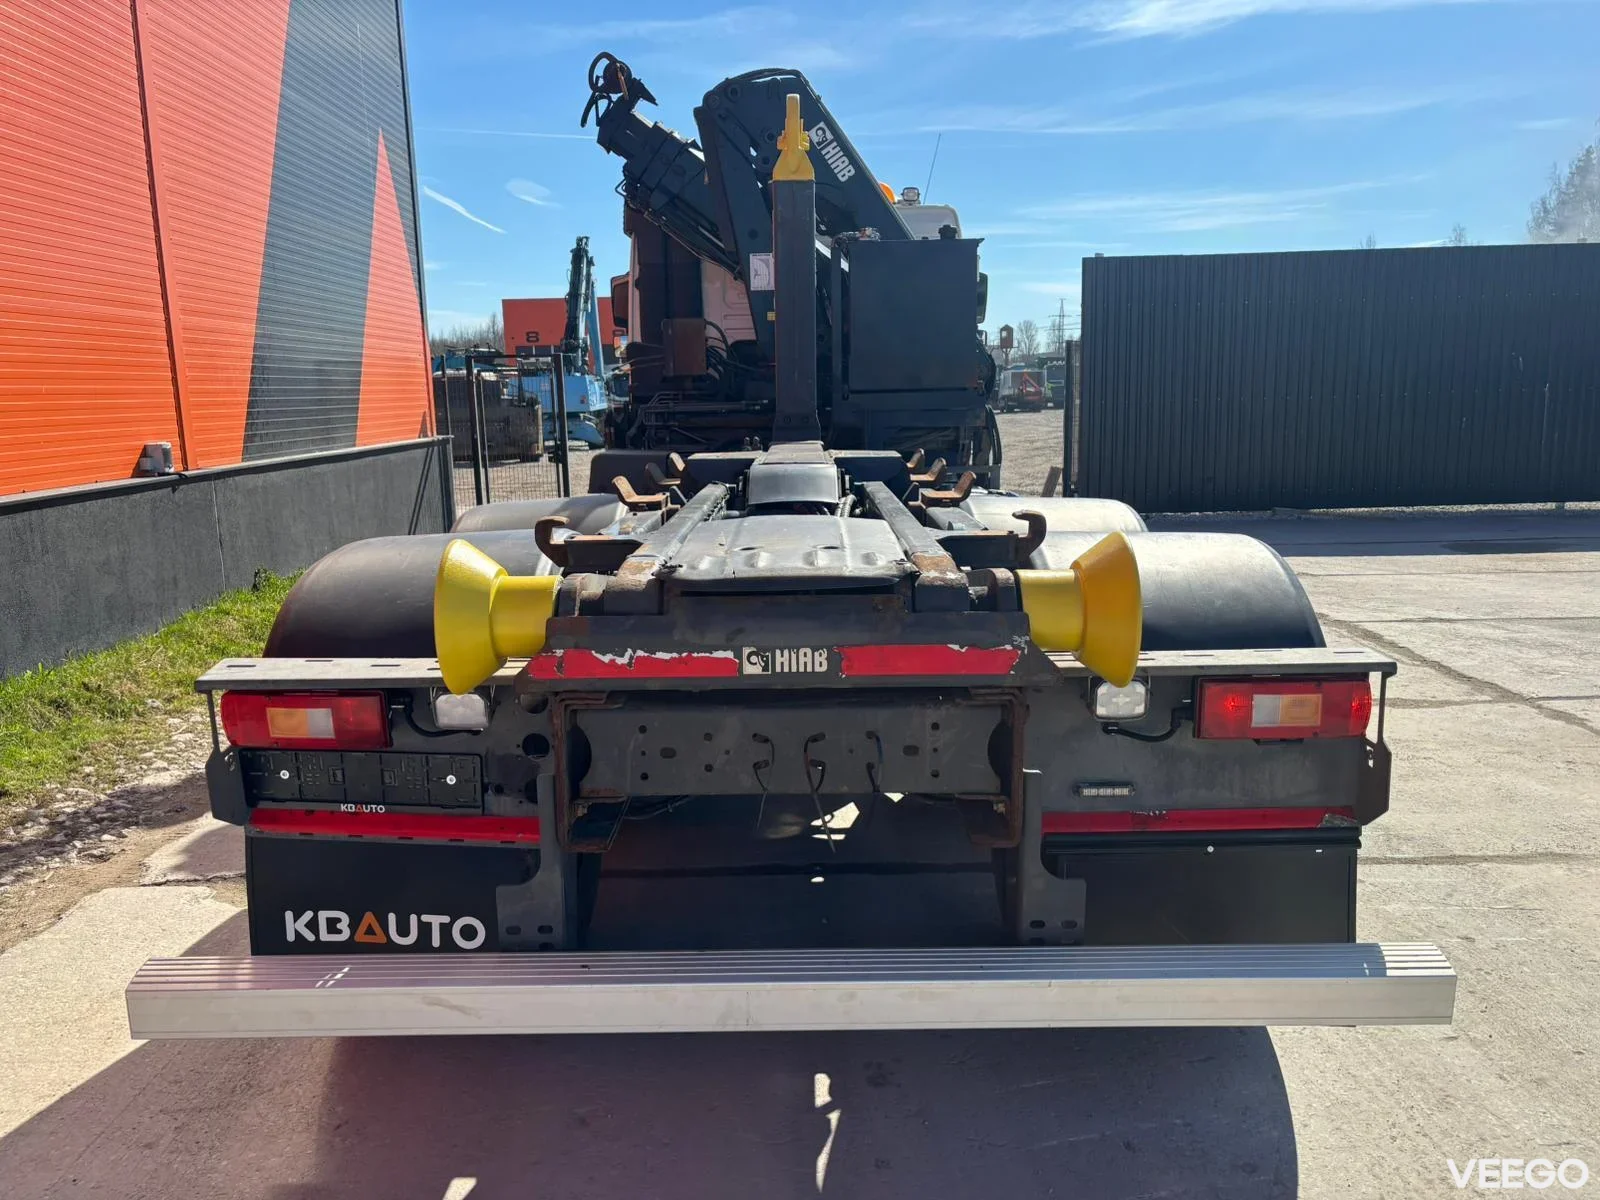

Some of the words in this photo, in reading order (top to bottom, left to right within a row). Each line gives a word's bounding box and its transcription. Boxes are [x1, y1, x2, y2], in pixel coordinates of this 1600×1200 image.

[821, 141, 856, 182] HIAB
[526, 331, 540, 343] 8
[775, 648, 828, 673] HIAB
[340, 803, 386, 813] KBAUTO
[284, 910, 486, 950] KBAUTO
